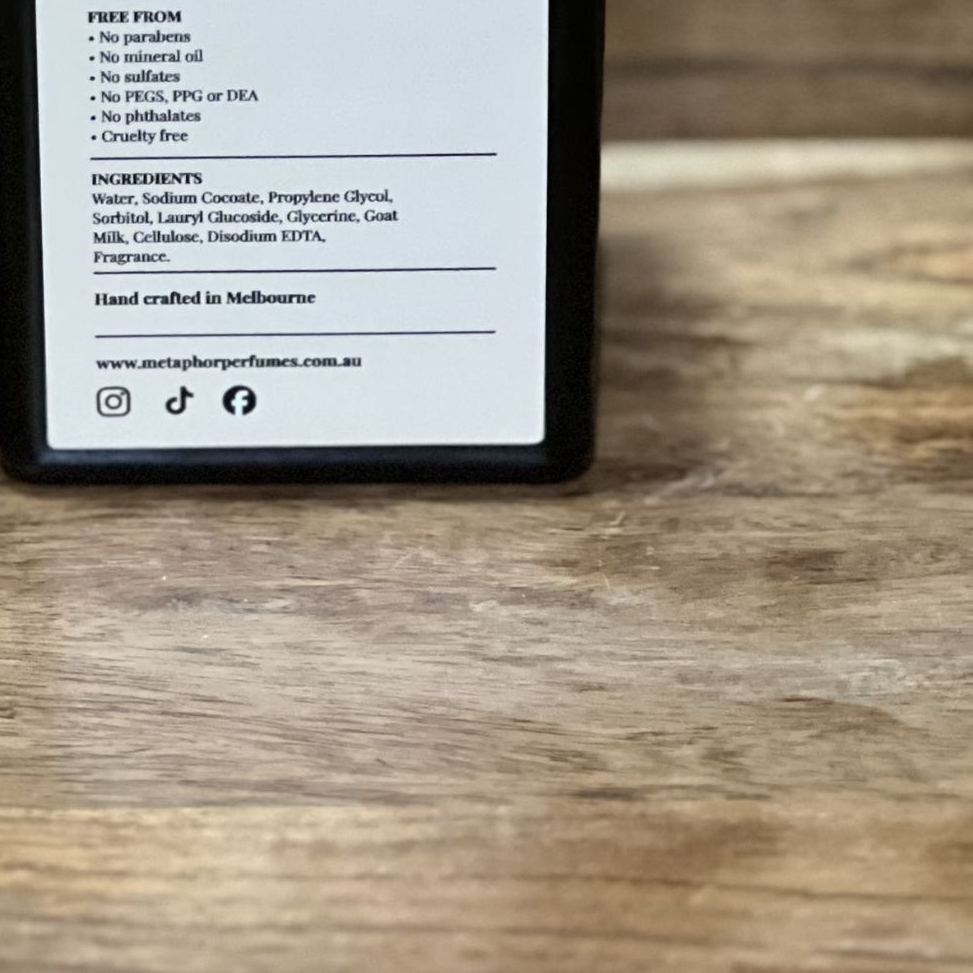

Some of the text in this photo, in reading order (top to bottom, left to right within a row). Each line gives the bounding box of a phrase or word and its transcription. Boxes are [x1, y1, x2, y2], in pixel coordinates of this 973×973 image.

[87, 11, 181, 23] FREE FROM
[99, 30, 190, 46] No parabens
[99, 49, 203, 63] No mineral oil
[100, 70, 180, 83] No sulfates
[100, 90, 258, 103] No PEGS, PPG or DEA
[101, 109, 201, 125] No phthalates
[101, 129, 188, 144] Cruelty free
[91, 173, 202, 185] INGREDIENTS
[91, 189, 393, 205] Water, Sodium Cocoate, Propylene Glycol,
[92, 210, 398, 225] Sorbitol, Lauryl Glucoside, Glycerine, Goat
[93, 230, 326, 244] Milk, Cellulose, Disodium EDTA,
[93, 251, 170, 265] Fragrance.
[94, 291, 315, 305] Hand crafted in Melbourne
[96, 355, 361, 371] www.metaphorperfumes.com.au
